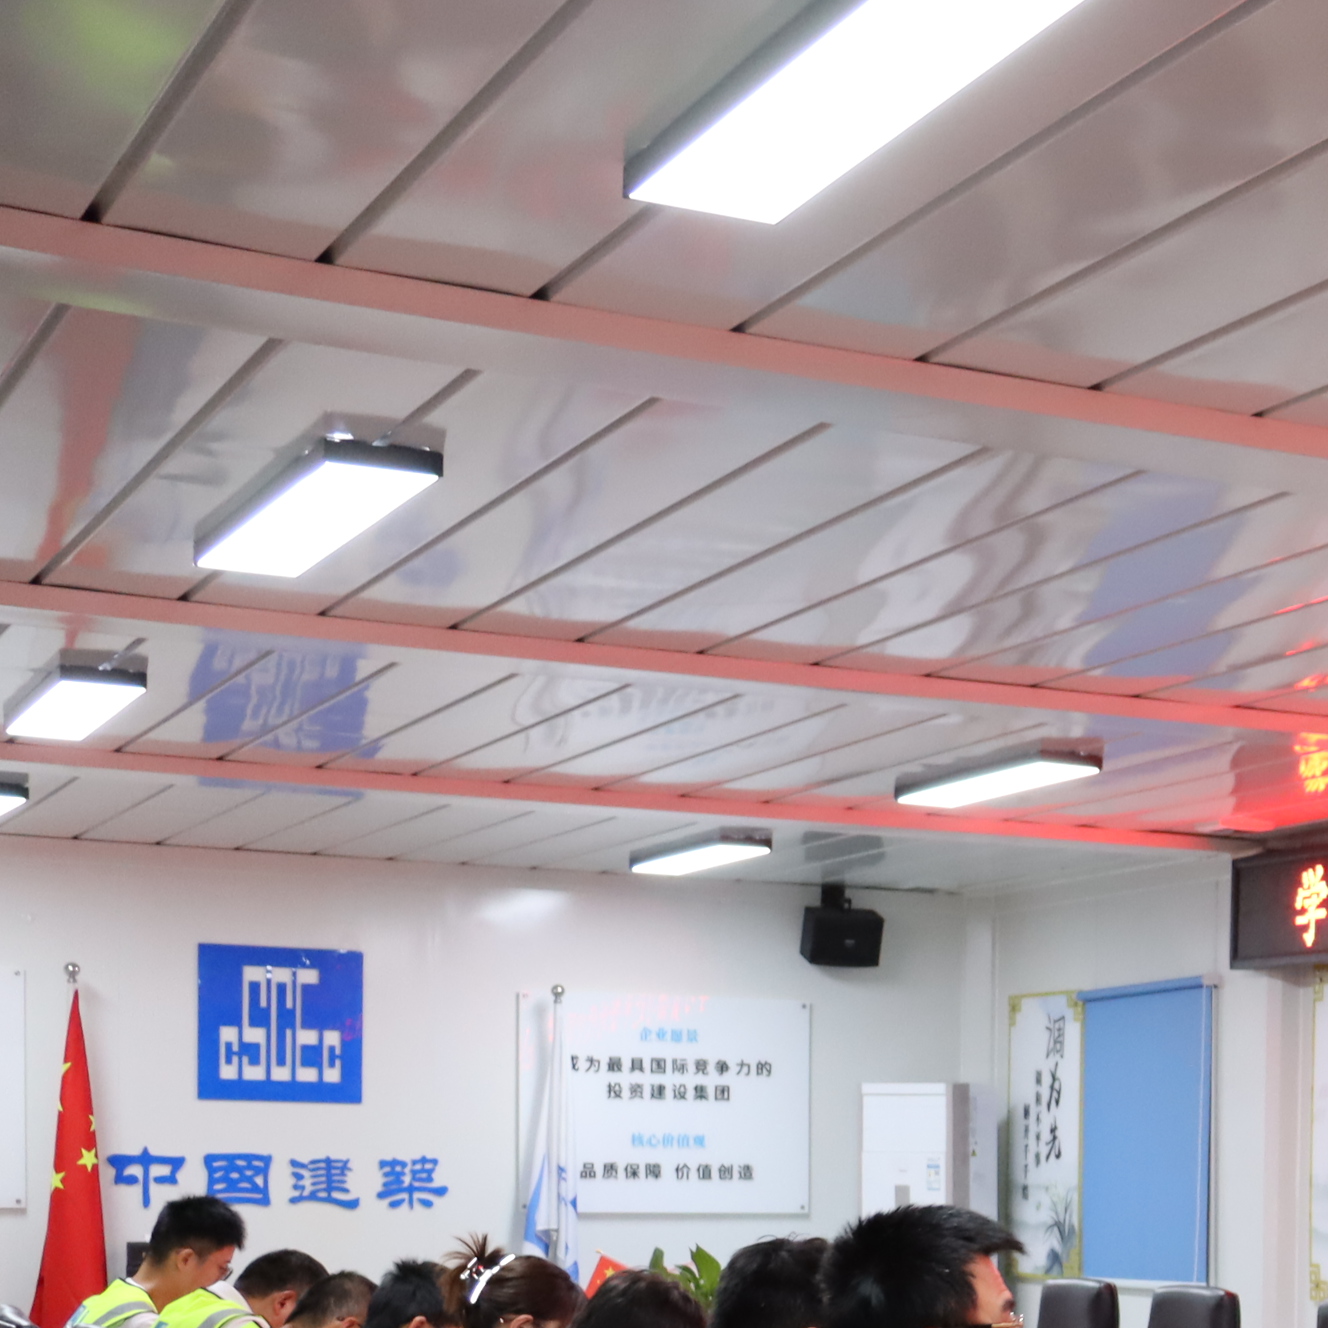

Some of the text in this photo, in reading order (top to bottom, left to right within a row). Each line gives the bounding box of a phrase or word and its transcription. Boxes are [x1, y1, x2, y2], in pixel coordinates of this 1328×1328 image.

[606, 1083, 731, 1101] 投资建设集团
[107, 1146, 448, 1210] 中國建築
[580, 1162, 755, 1181] 品质保障 价值创造
